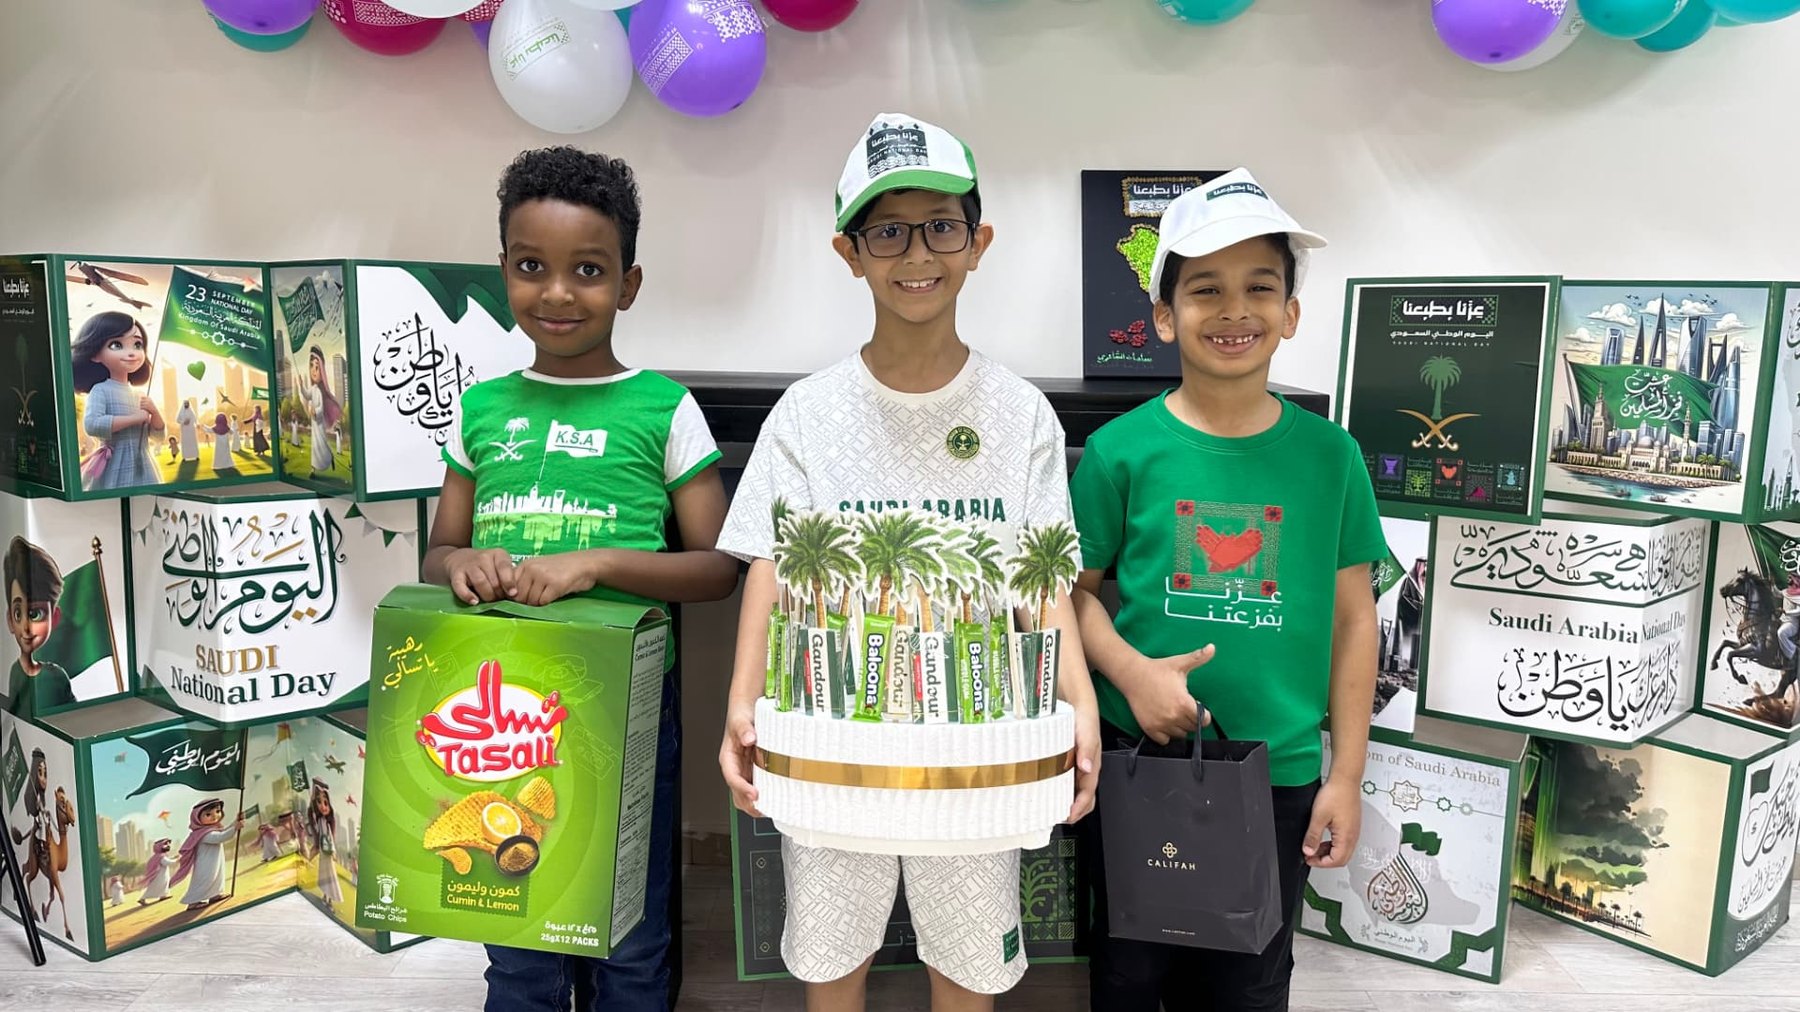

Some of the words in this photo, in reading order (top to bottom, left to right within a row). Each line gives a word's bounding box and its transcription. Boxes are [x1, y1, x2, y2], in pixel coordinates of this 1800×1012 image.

[185, 284, 207, 302] 23
[212, 290, 257, 308] SEPTEMBER
[211, 298, 240, 312] NATIONAL
[240, 306, 253, 315] DAY
[1402, 300, 1454, 321] بطبعنا
[179, 312, 209, 325] Kingdom
[220, 323, 239, 334] Saudi
[239, 329, 261, 340] Arabia
[1390, 329, 1431, 339] السعودي
[1431, 330, 1464, 340] الوطني
[1463, 331, 1494, 339] اليوم
[555, 430, 594, 446] K.S.A
[1488, 606, 1553, 633] Saudi
[1558, 616, 1638, 644] Arabia
[1642, 612, 1673, 641] National
[195, 644, 279, 677] SAUDI
[387, 636, 423, 663] رهيبة
[812, 633, 825, 712] Gandour
[893, 629, 909, 708] Gandour
[924, 635, 941, 718] Gandour
[1042, 634, 1054, 712] Gandour
[170, 665, 260, 706] National
[270, 670, 337, 700] Day
[416, 660, 569, 747] تسالي
[155, 739, 205, 775] الوطني
[203, 741, 241, 775] اليوم
[435, 737, 557, 777] Tasali
[1388, 754, 1402, 766] of
[1404, 756, 1447, 775] Saudi
[1450, 765, 1501, 787] Arabia
[1147, 858, 1196, 871] CALIFAH
[447, 879, 488, 896] وليمون
[489, 885, 520, 897] كمون
[446, 893, 477, 907] Cumin
[477, 899, 485, 908] &
[486, 899, 520, 912] Lemon
[363, 911, 386, 920] Potato
[387, 913, 408, 922] Chips
[571, 936, 600, 947] PACKS
